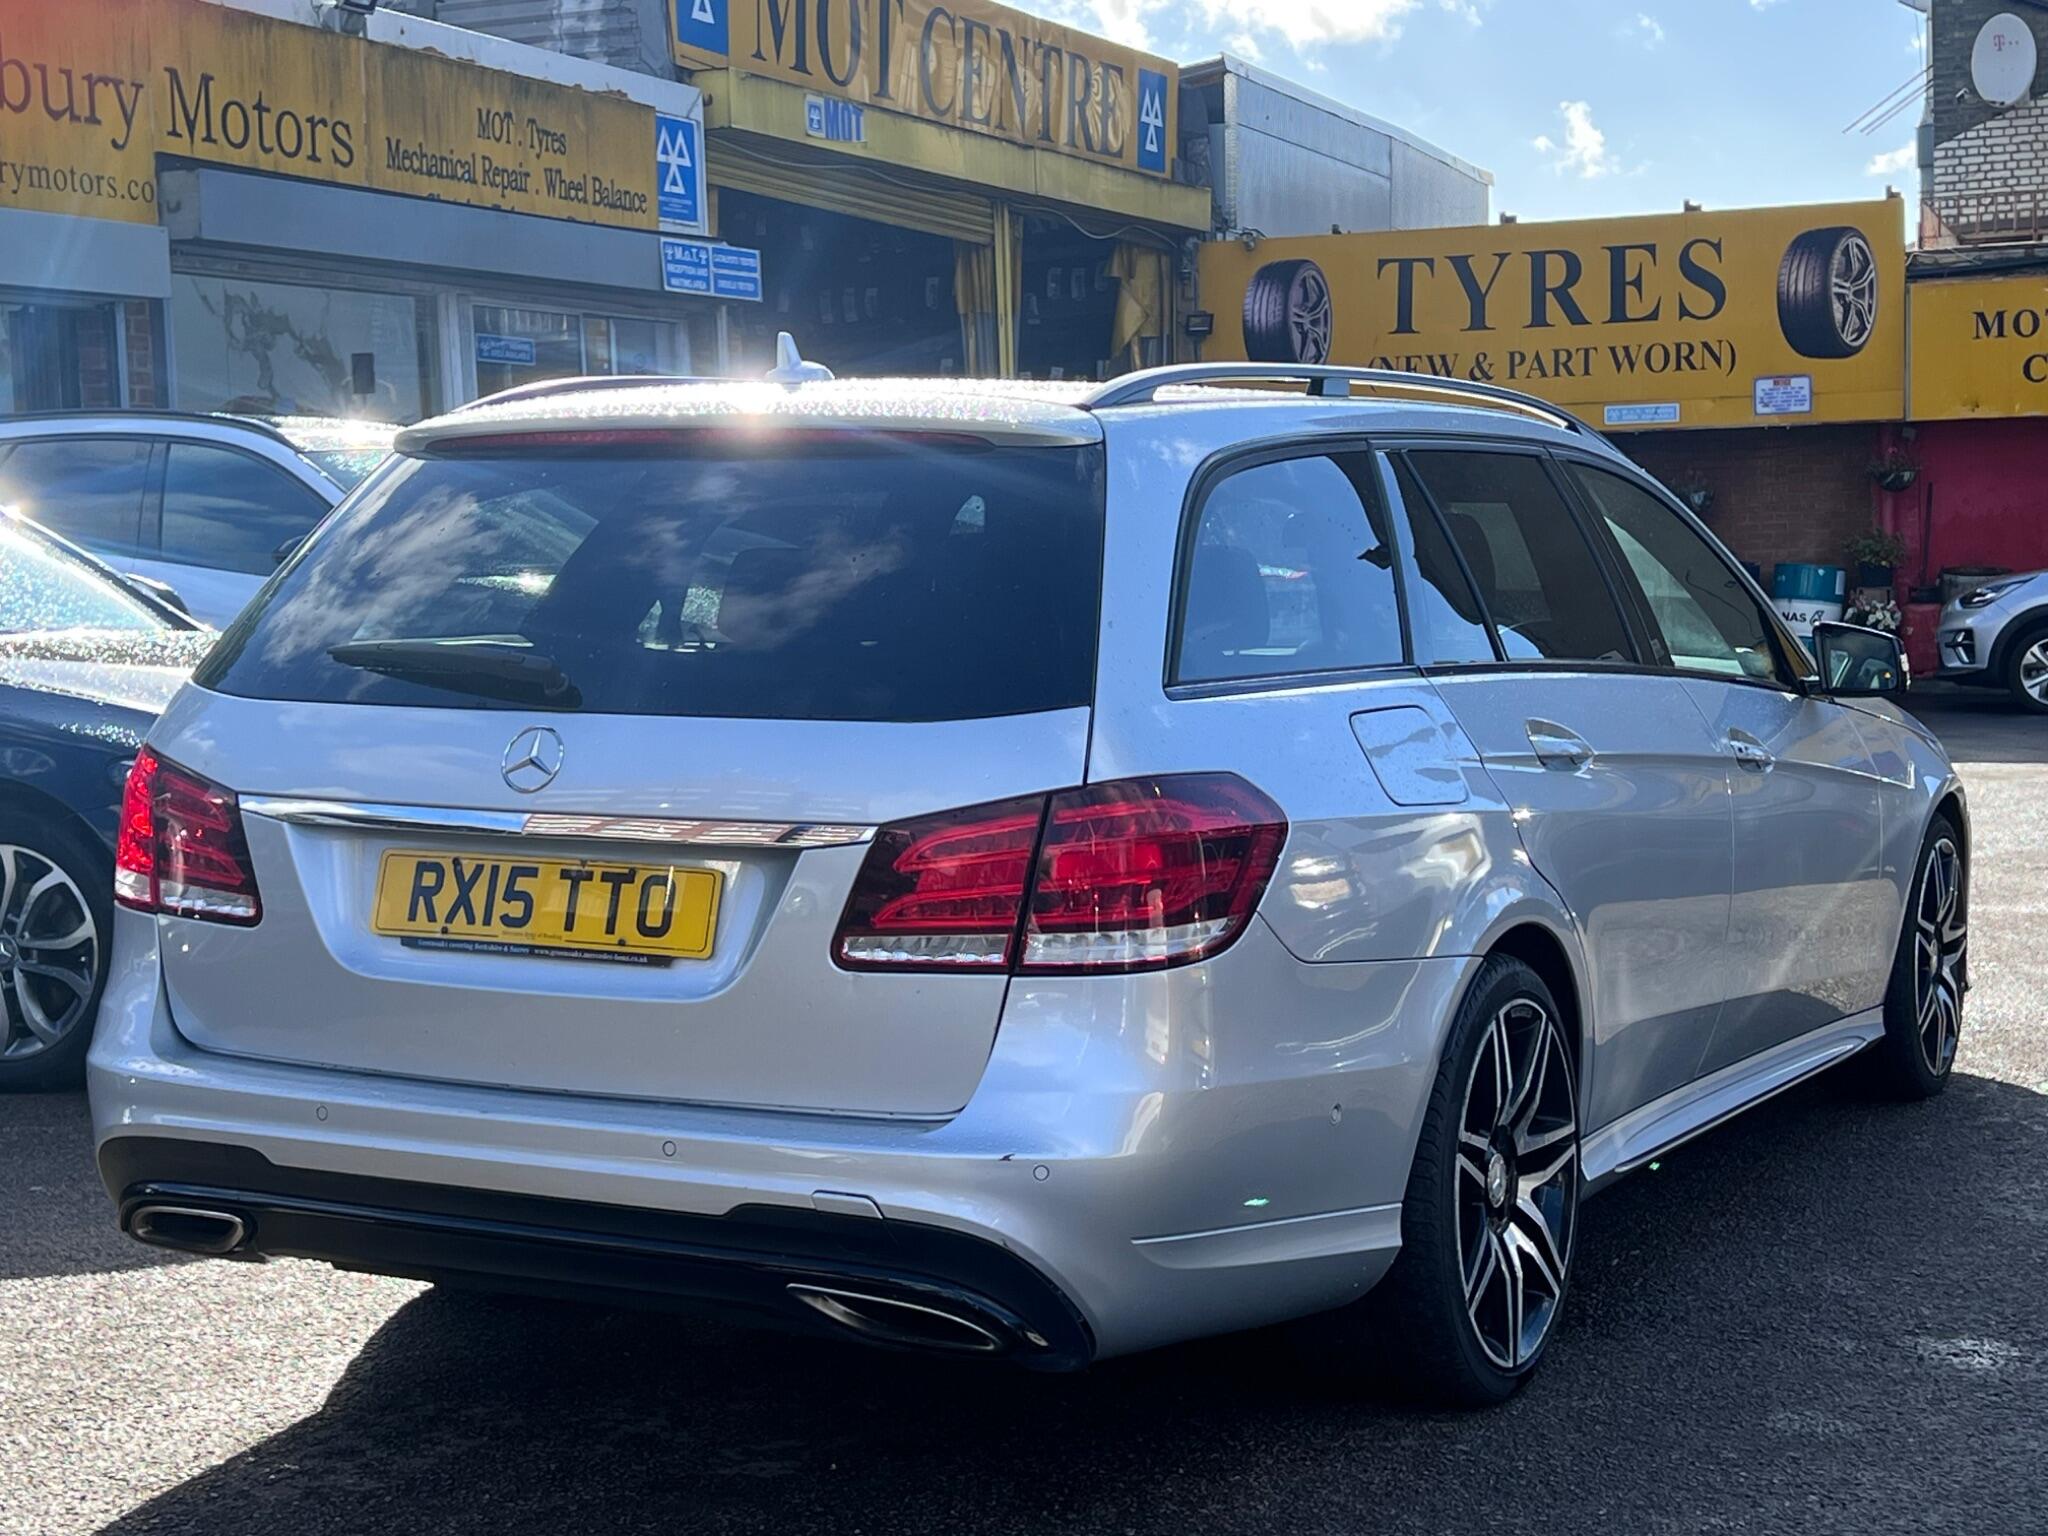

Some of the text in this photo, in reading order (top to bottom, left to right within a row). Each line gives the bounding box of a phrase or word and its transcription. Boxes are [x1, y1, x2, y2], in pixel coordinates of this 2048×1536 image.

[164, 66, 354, 168] Motors
[920, 6, 1125, 158] CENTRE
[477, 108, 514, 144] MOT
[527, 118, 567, 159] Tyres
[386, 137, 477, 185] Mechanical
[482, 156, 531, 198] Repair
[544, 168, 588, 205] Wheel
[592, 176, 647, 214] Balance
[1376, 237, 1727, 335] TYRES
[1972, 308, 2048, 340] MO
[1468, 352, 1494, 381] &
[1507, 347, 1598, 380] PART
[1608, 339, 1737, 377] WORN)
[407, 860, 678, 938] RX15 TTO
